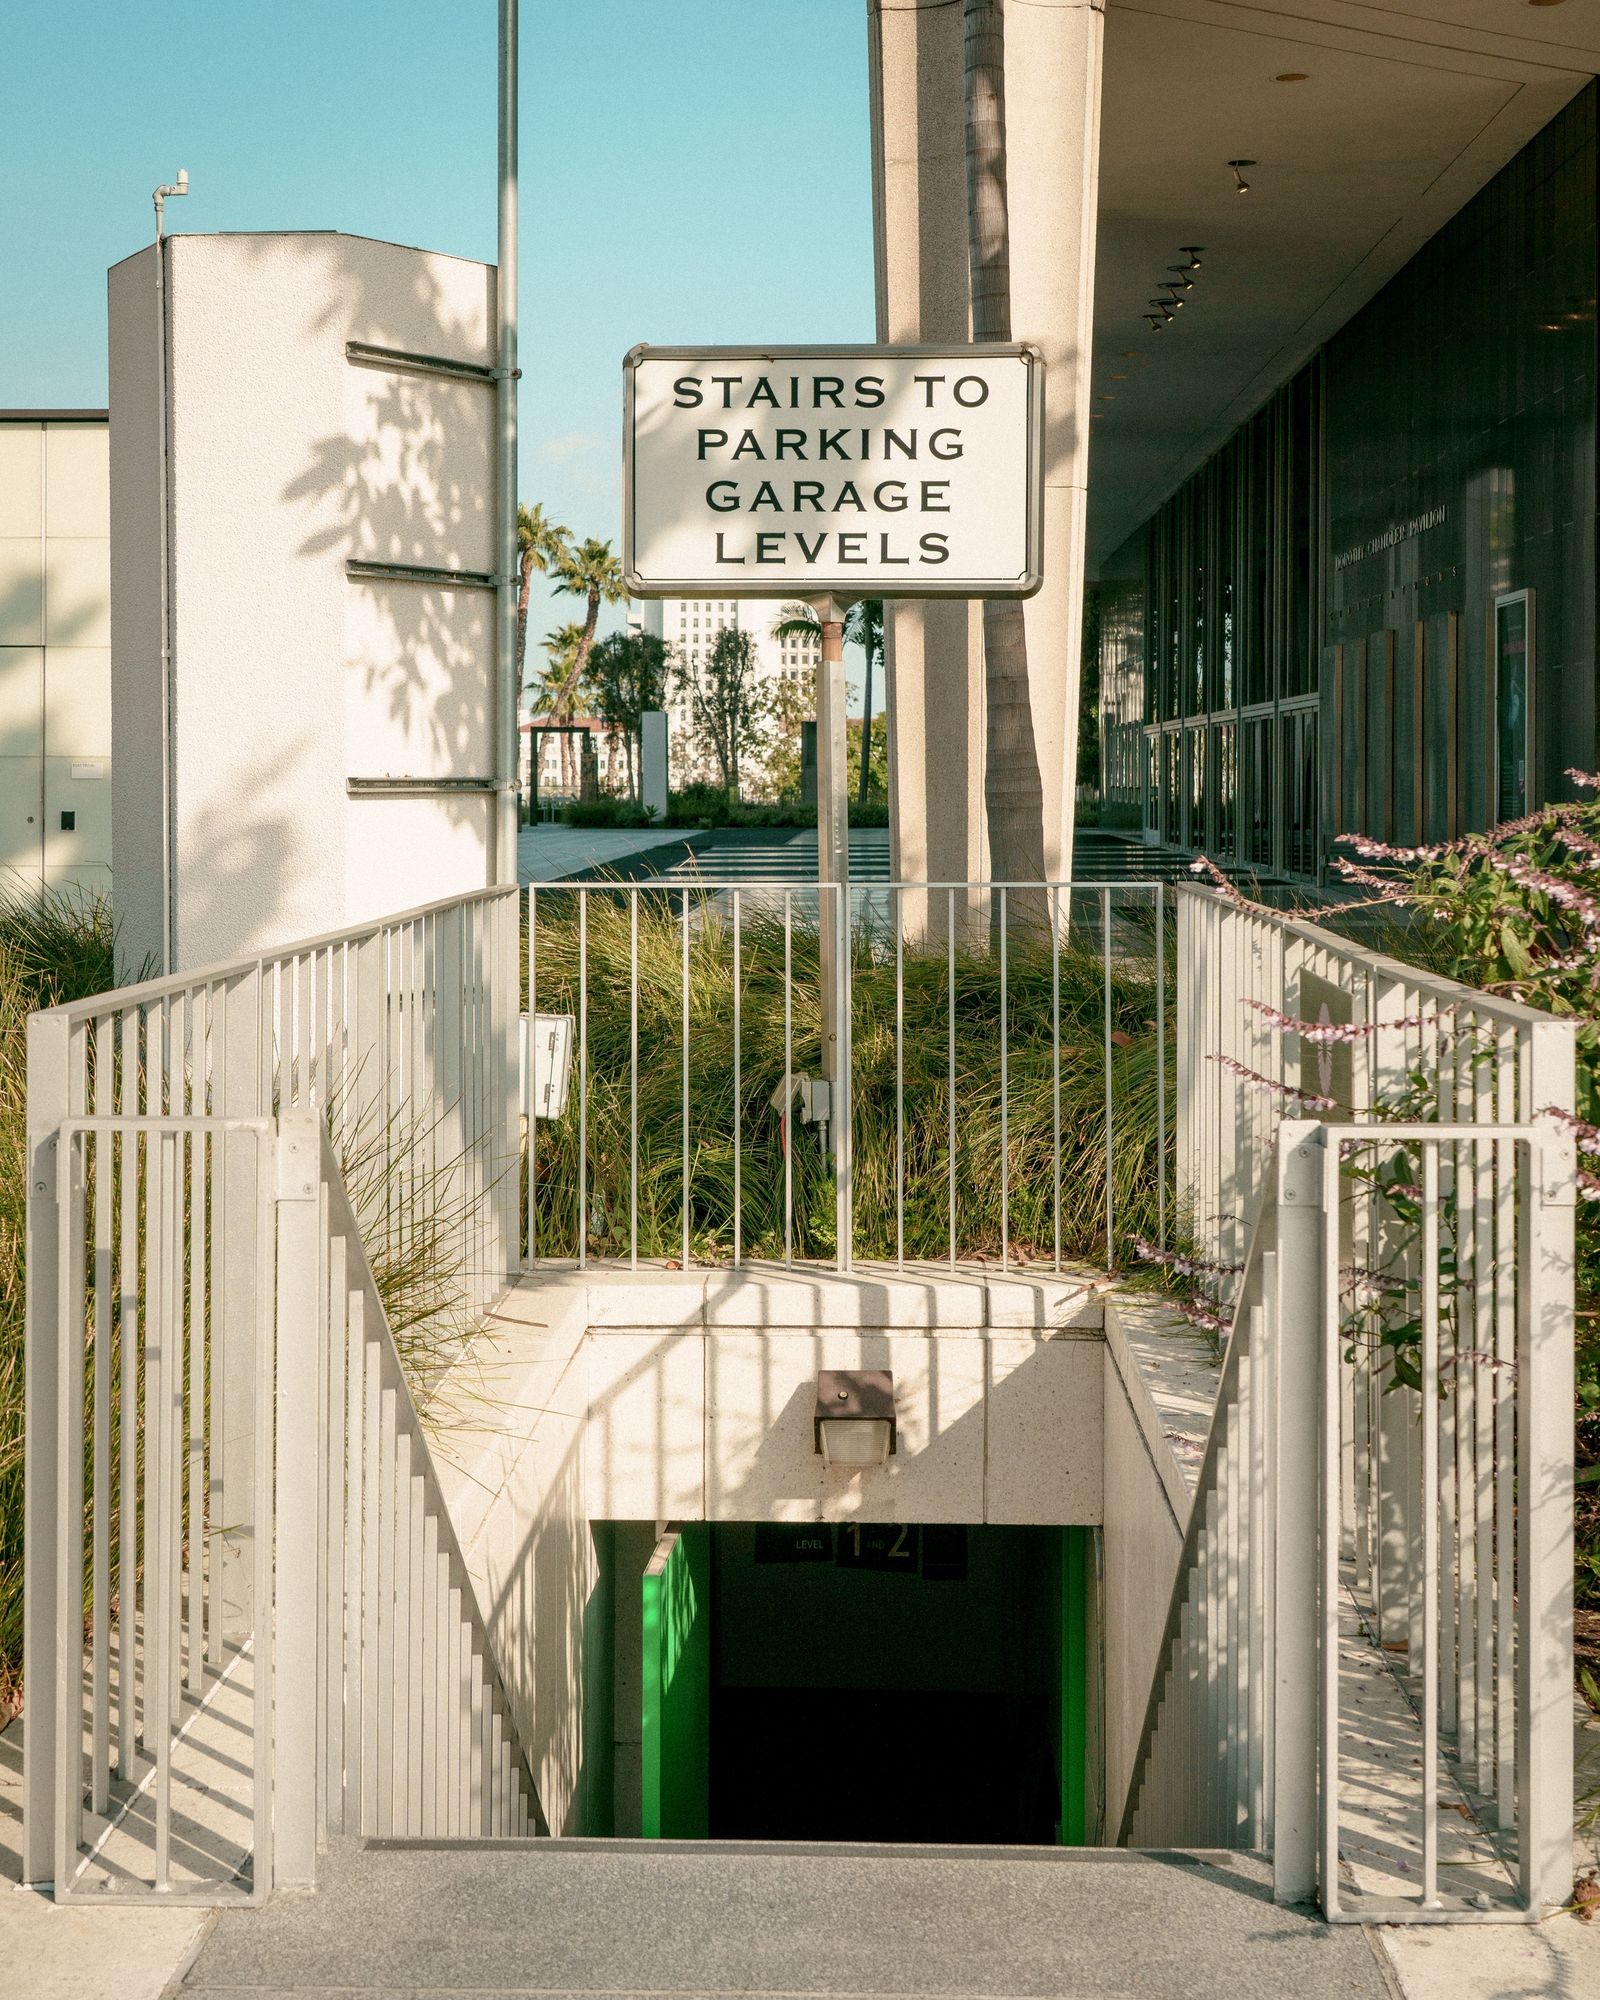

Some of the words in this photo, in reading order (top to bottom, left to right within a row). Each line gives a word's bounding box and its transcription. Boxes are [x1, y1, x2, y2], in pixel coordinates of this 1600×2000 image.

[673, 376, 886, 409] STAIRS
[914, 375, 990, 408] TO
[697, 427, 964, 460] PARKING
[705, 480, 951, 512] GARAGE
[1409, 505, 1447, 537] PAVILION
[715, 532, 950, 565] LEVELS
[796, 1540, 824, 1549] LEVEL
[847, 1523, 860, 1557] 1
[888, 1523, 910, 1557] 2
